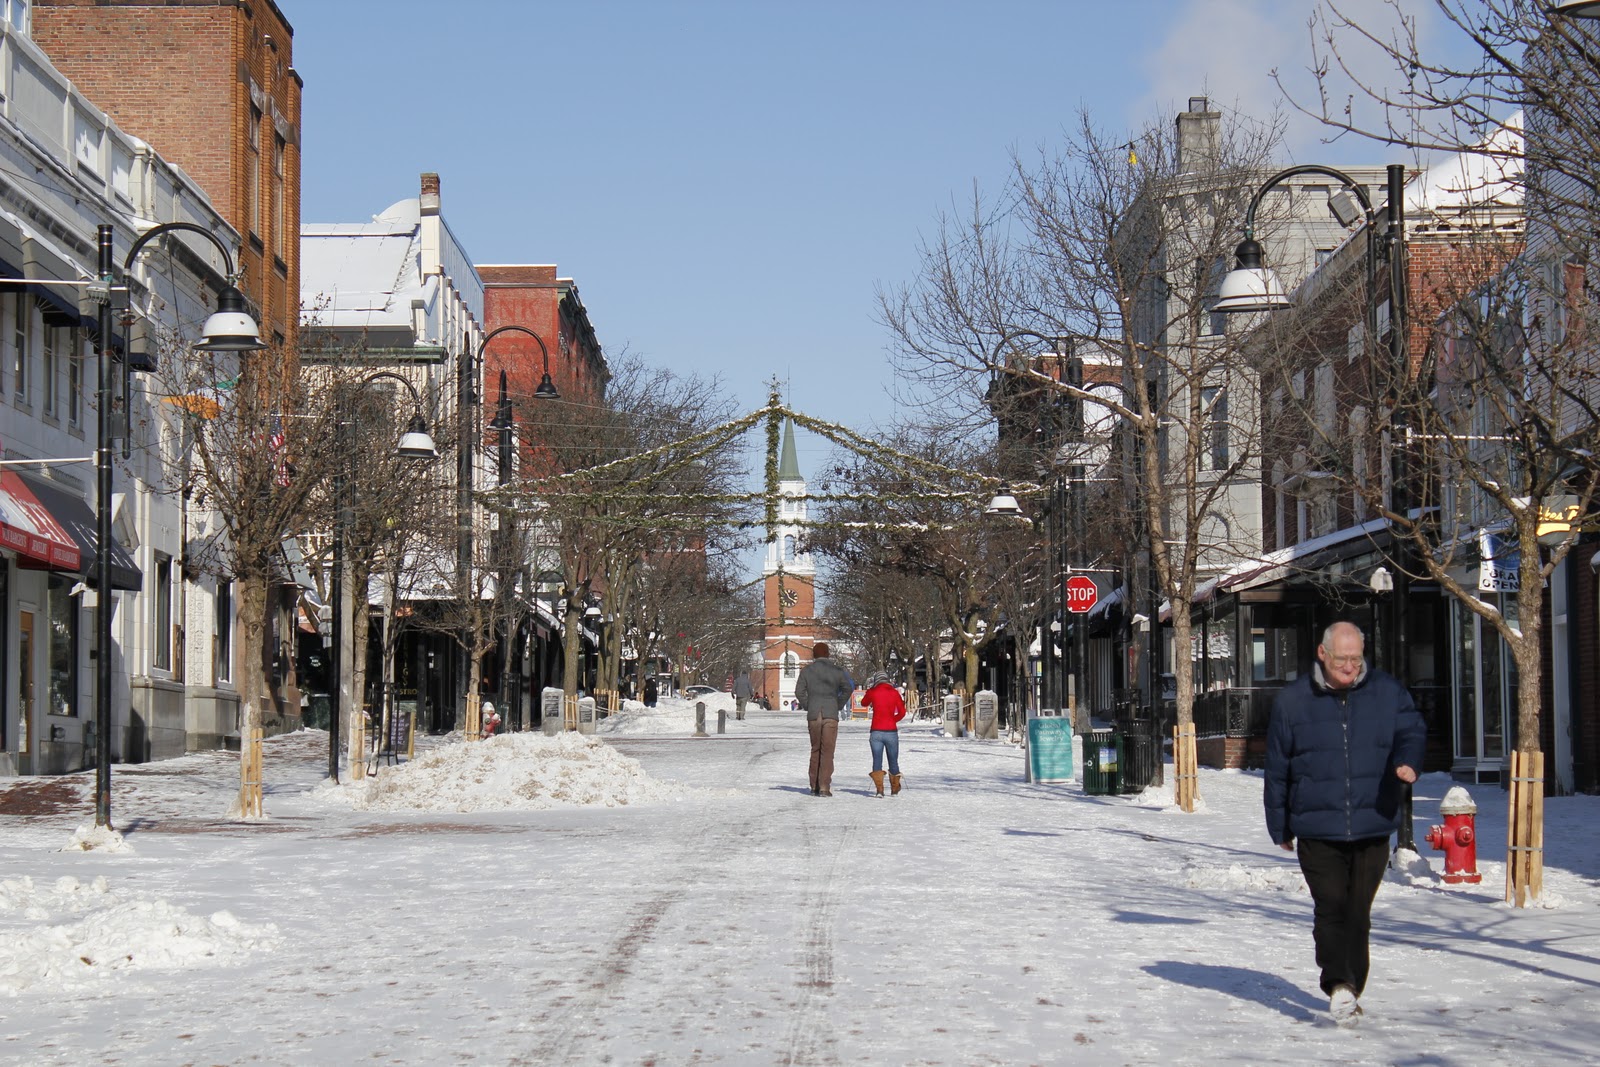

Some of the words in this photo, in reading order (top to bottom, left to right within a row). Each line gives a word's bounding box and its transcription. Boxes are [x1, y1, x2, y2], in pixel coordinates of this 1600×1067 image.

[1489, 568, 1520, 580] GRA
[1482, 578, 1520, 590] OPEN
[1067, 588, 1095, 601] STOP
